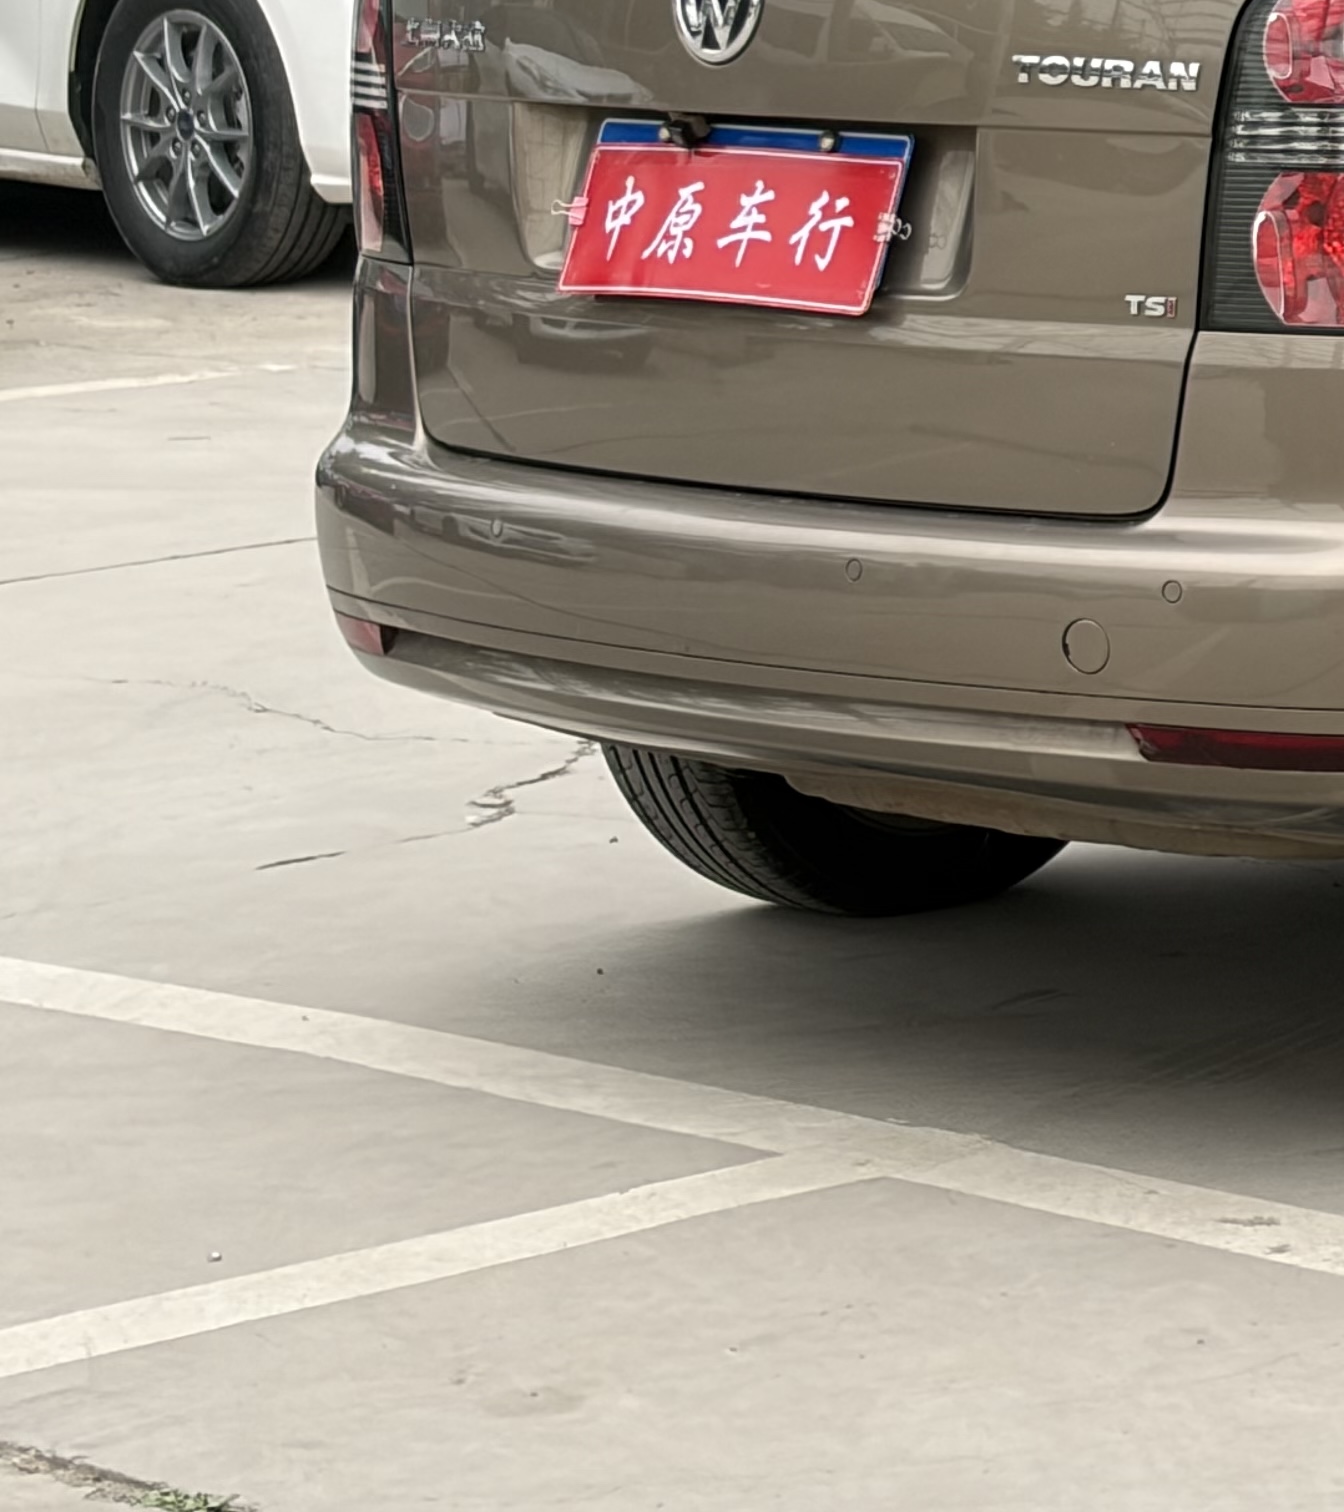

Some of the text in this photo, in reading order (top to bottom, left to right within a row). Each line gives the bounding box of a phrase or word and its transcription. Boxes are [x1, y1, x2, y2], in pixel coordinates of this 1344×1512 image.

[1012, 55, 1200, 91] TOURAN
[603, 175, 855, 271] 中原车行
